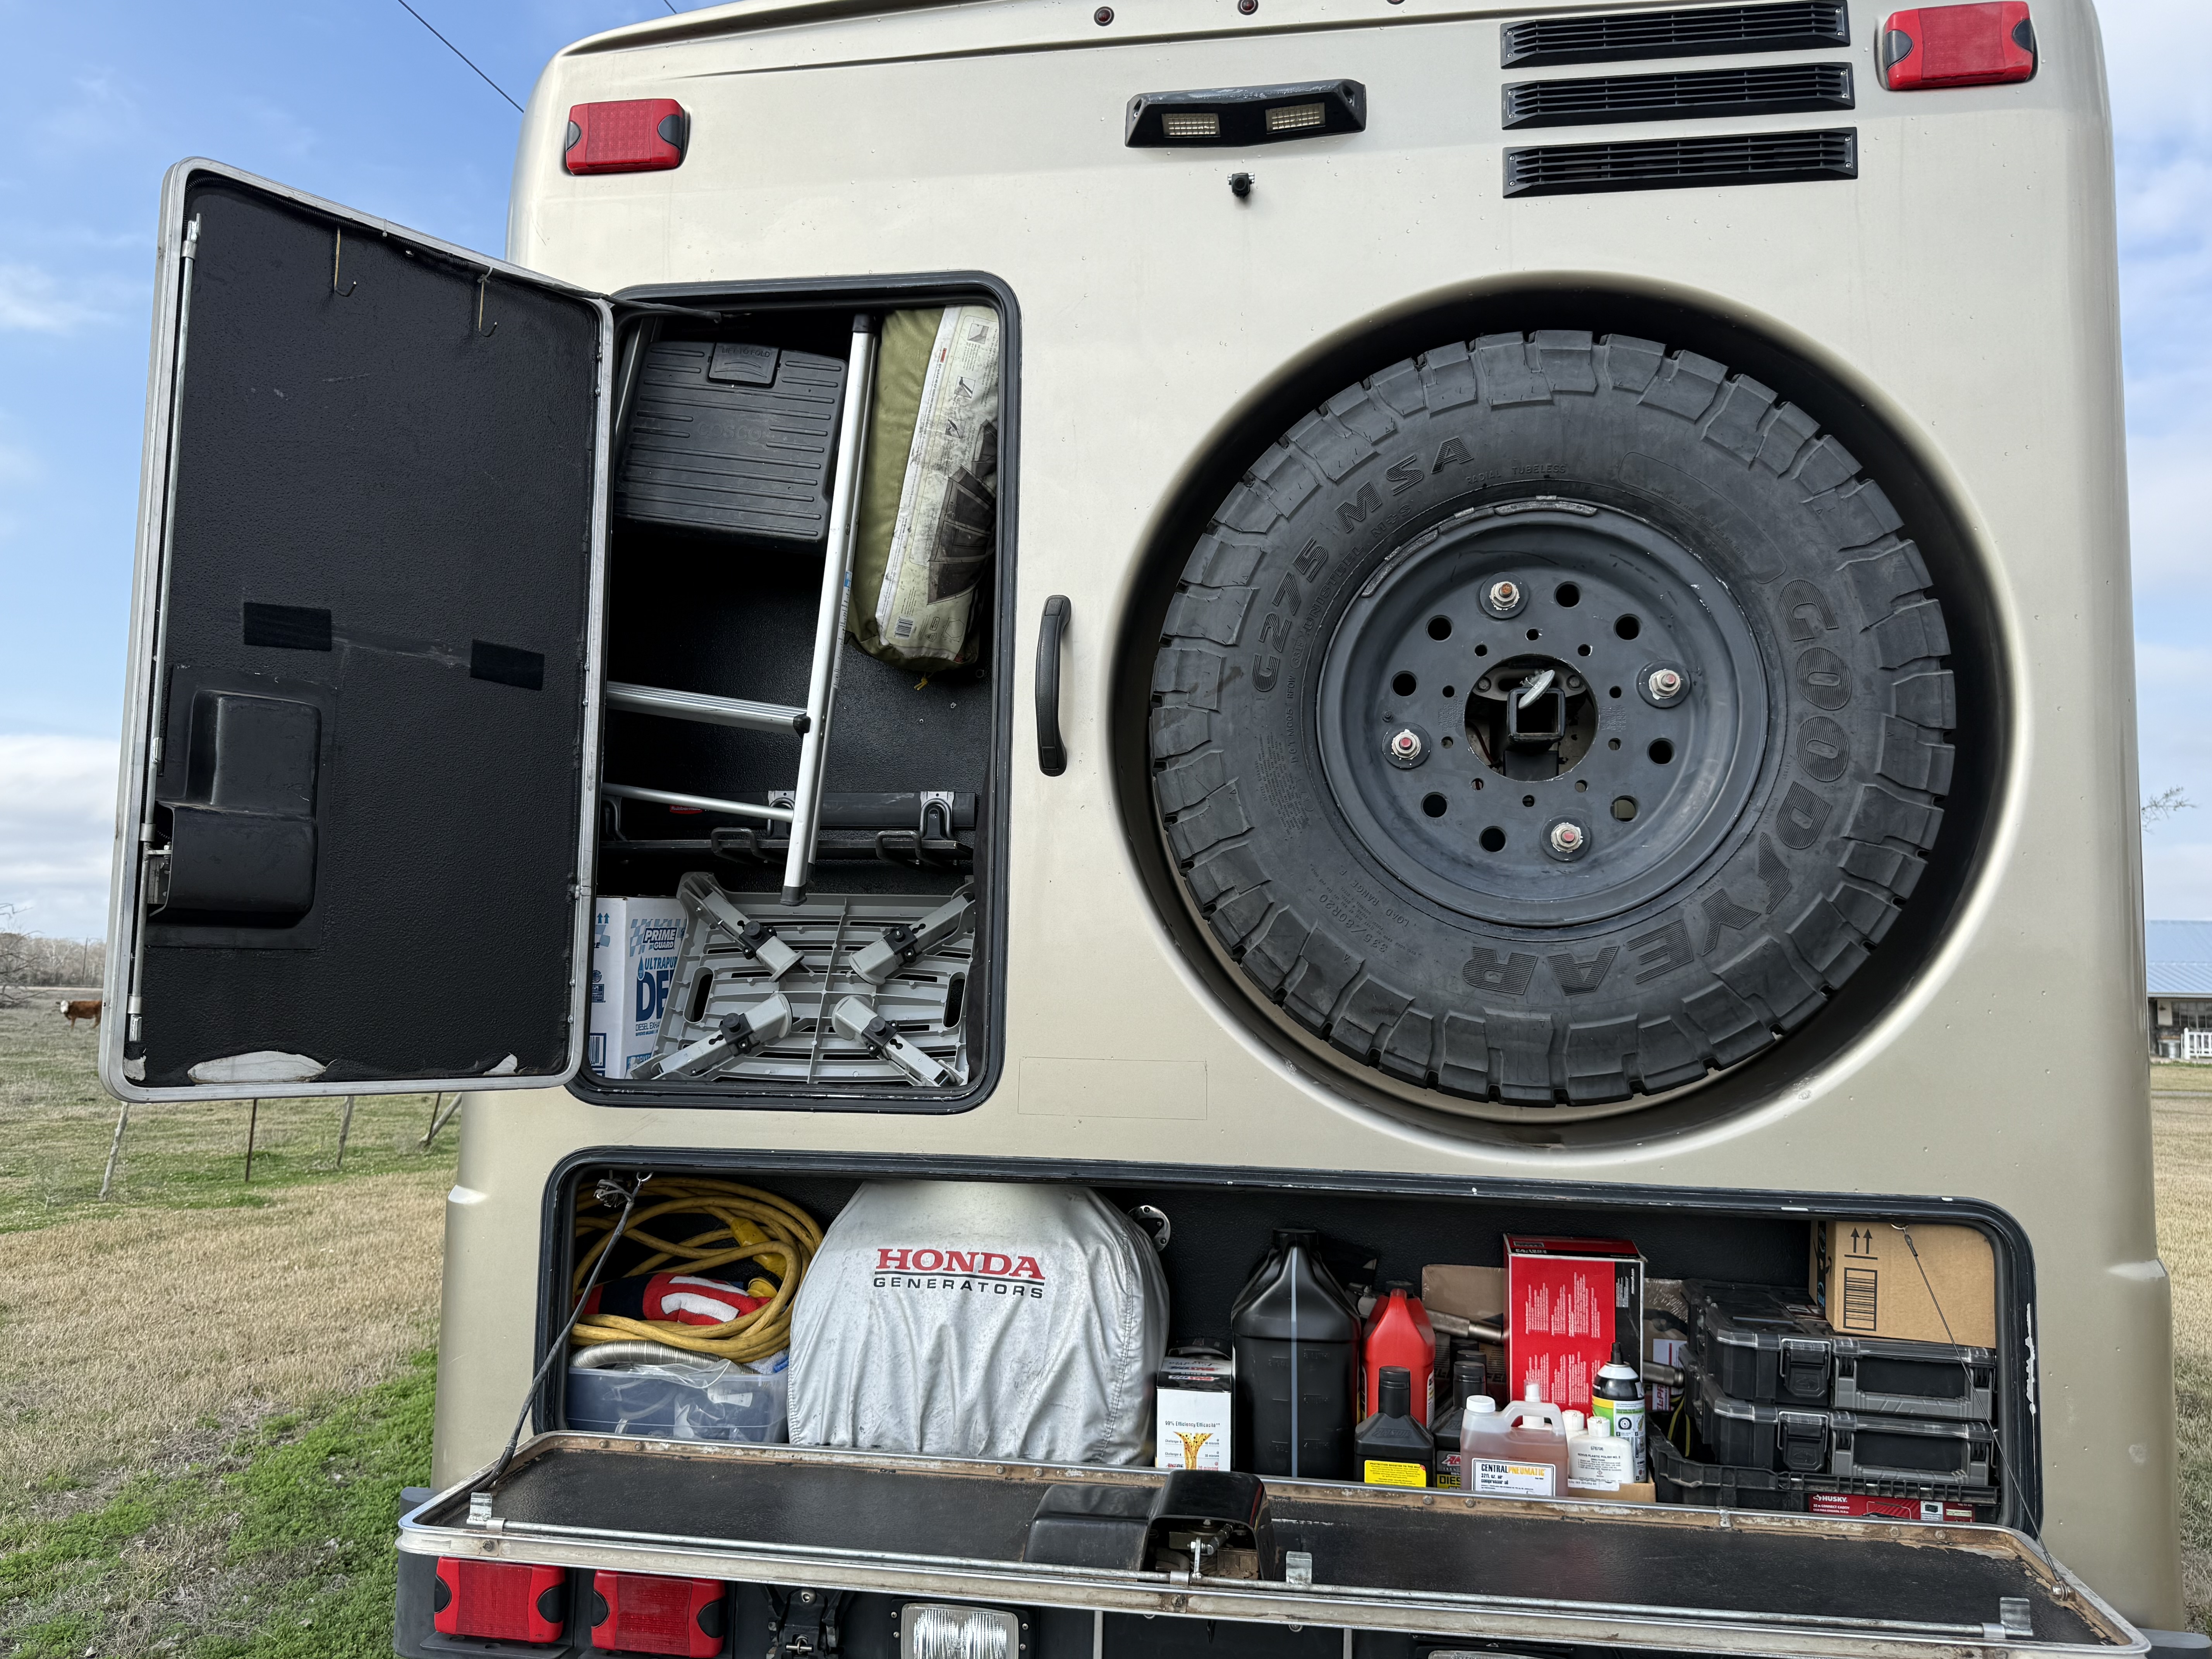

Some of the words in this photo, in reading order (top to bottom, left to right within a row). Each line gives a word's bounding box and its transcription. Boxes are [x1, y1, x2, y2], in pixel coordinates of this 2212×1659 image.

[750, 349, 770, 357] FOLD
[698, 422, 761, 441] COSCO
[1465, 468, 1501, 486] RADIAL
[1511, 463, 1567, 475] TUBELESS
[1252, 537, 1328, 692] G275
[1334, 436, 1474, 533] MSA
[1302, 540, 1365, 631] UNISTEEL
[1369, 501, 1413, 539] M+S
[1462, 579, 1852, 996] GOODYEAR
[1349, 877, 1380, 908] RANGE
[1705, 876, 1721, 893] MADE
[1317, 893, 1389, 954] 335/80R20
[1384, 906, 1410, 929] LOAD
[644, 929, 675, 941] PRIME
[635, 970, 674, 1022] DE
[635, 1023, 648, 1031] DIESEL
[876, 1249, 1046, 1280] HONDA
[873, 1278, 1043, 1298] GENERATORS
